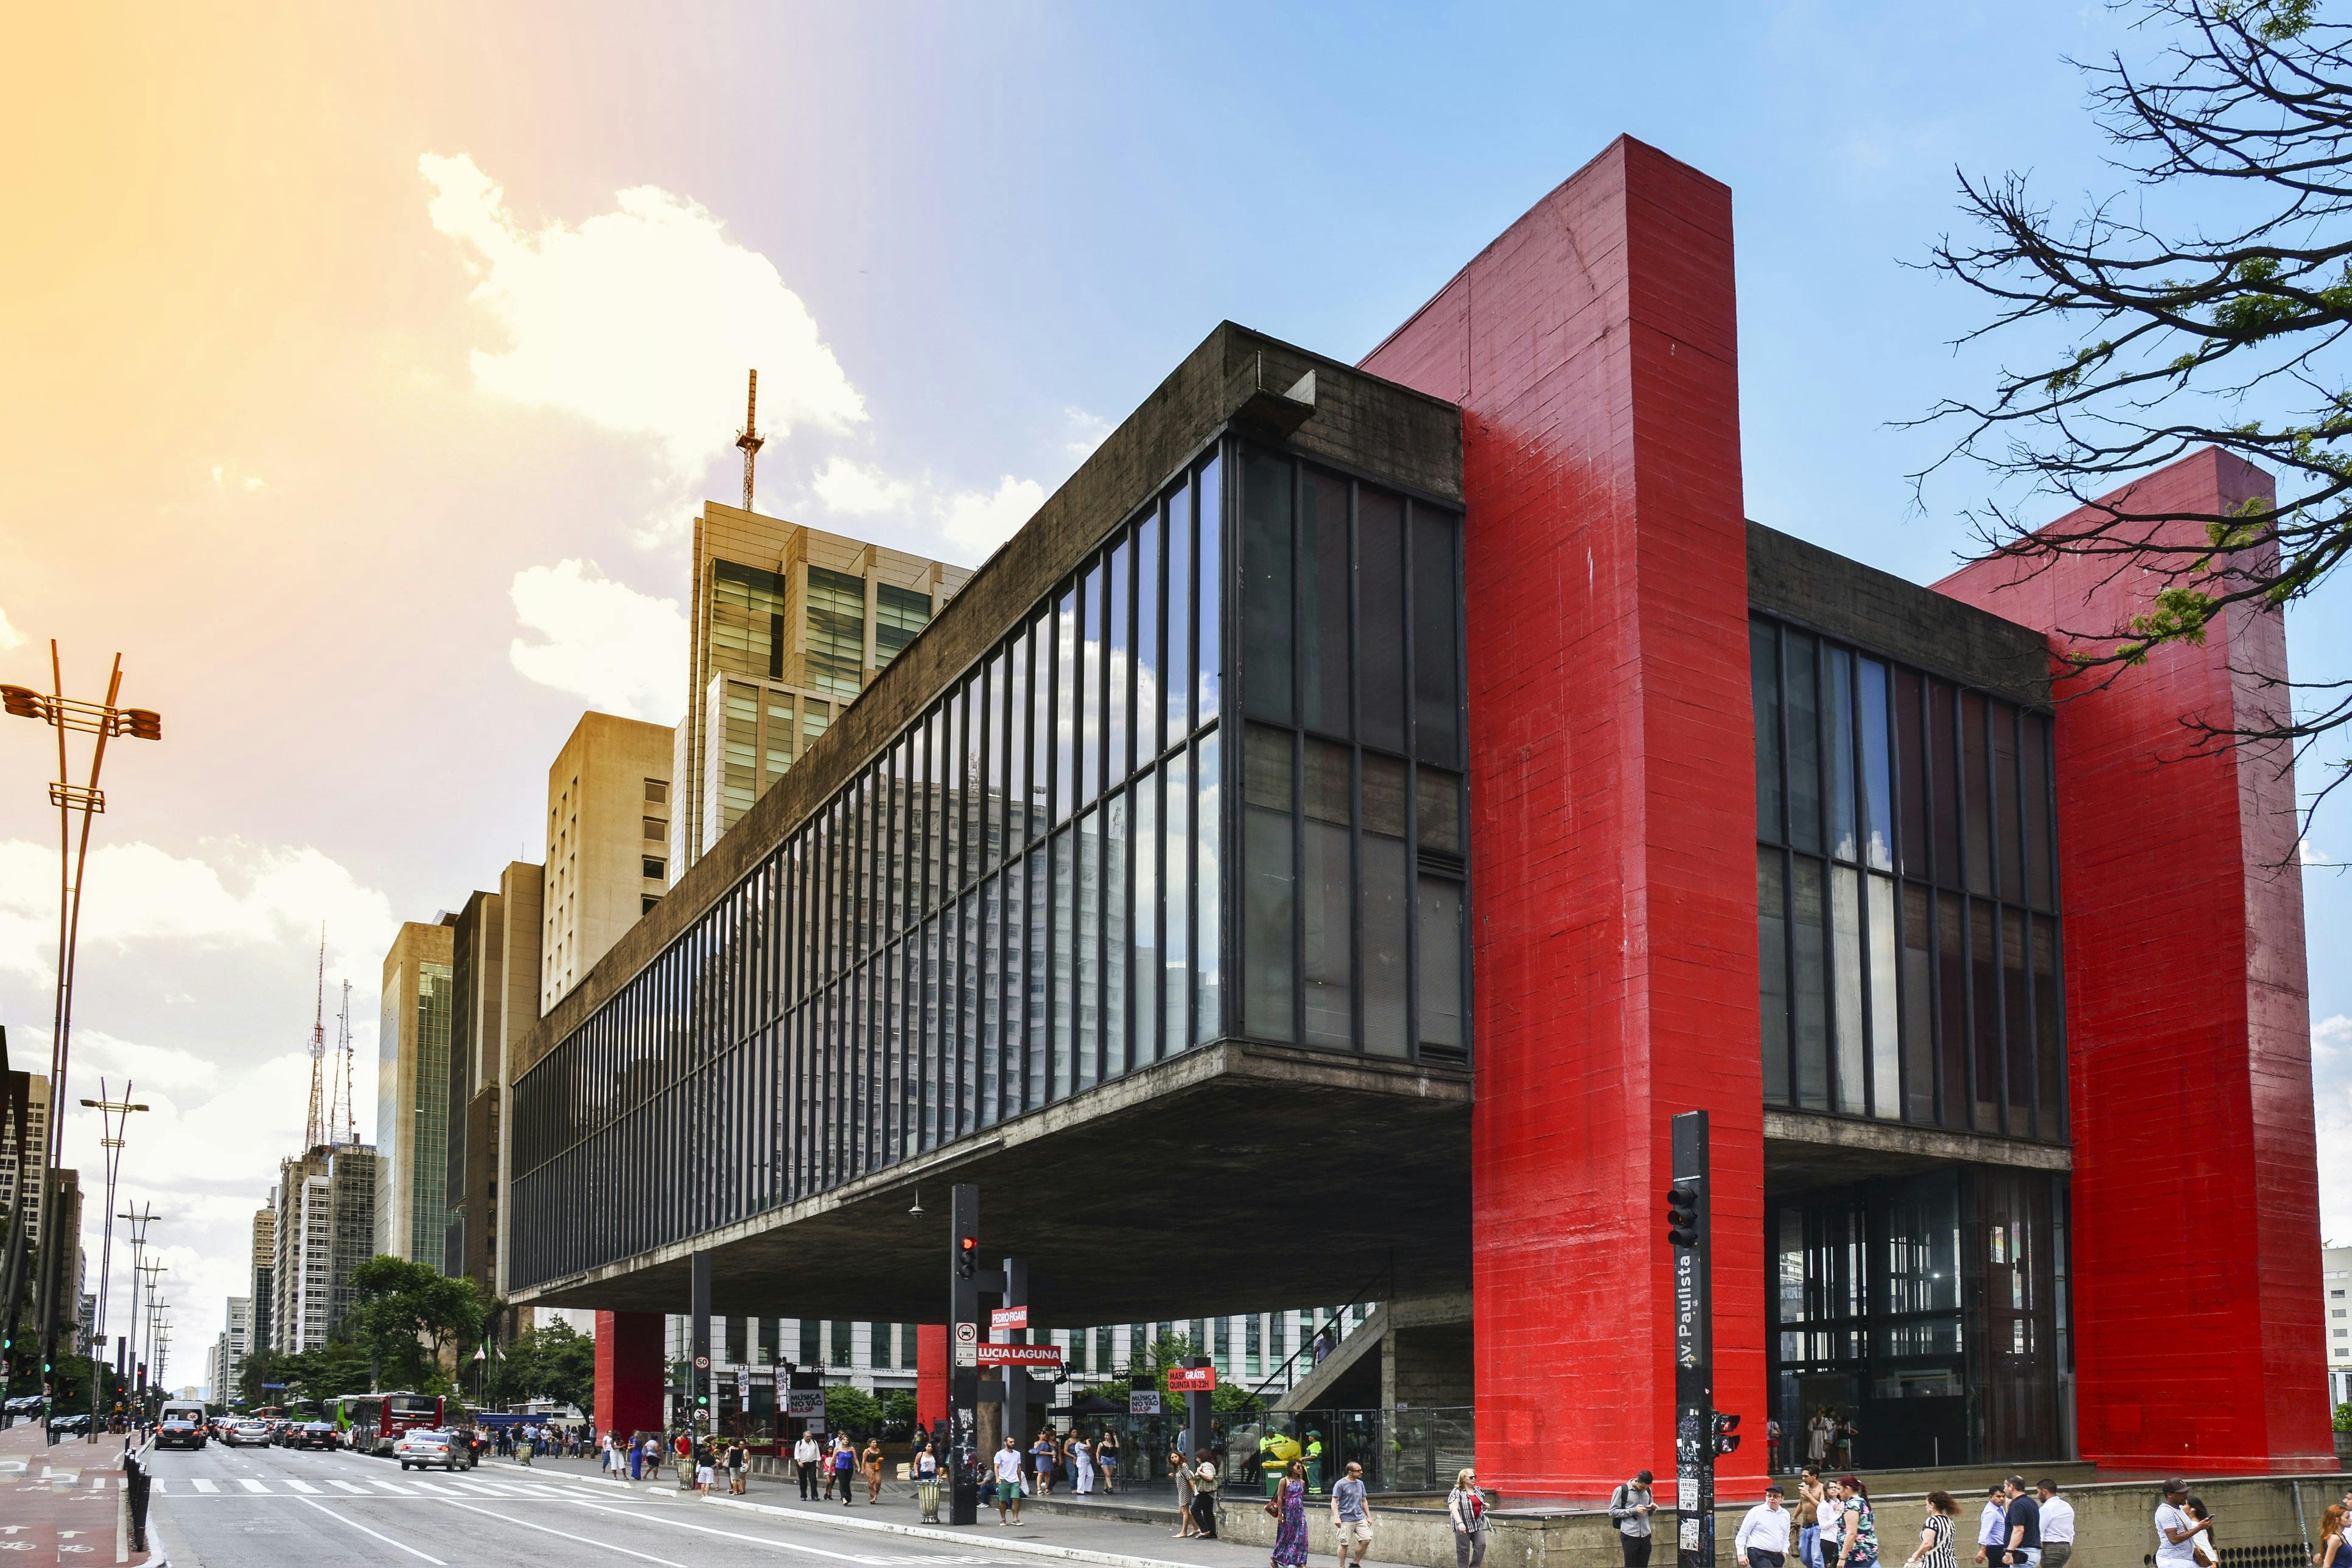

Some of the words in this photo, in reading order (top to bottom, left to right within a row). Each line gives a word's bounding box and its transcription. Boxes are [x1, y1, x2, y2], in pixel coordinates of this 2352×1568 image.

[1678, 1255, 1692, 1337] Paulista
[992, 1313, 1009, 1323] PEDRO
[1009, 1310, 1026, 1322] FIGARI
[978, 1348, 1010, 1358] LUCIA
[1012, 1349, 1059, 1359] LAGUNA
[1185, 1370, 1205, 1379] GRÁTIS
